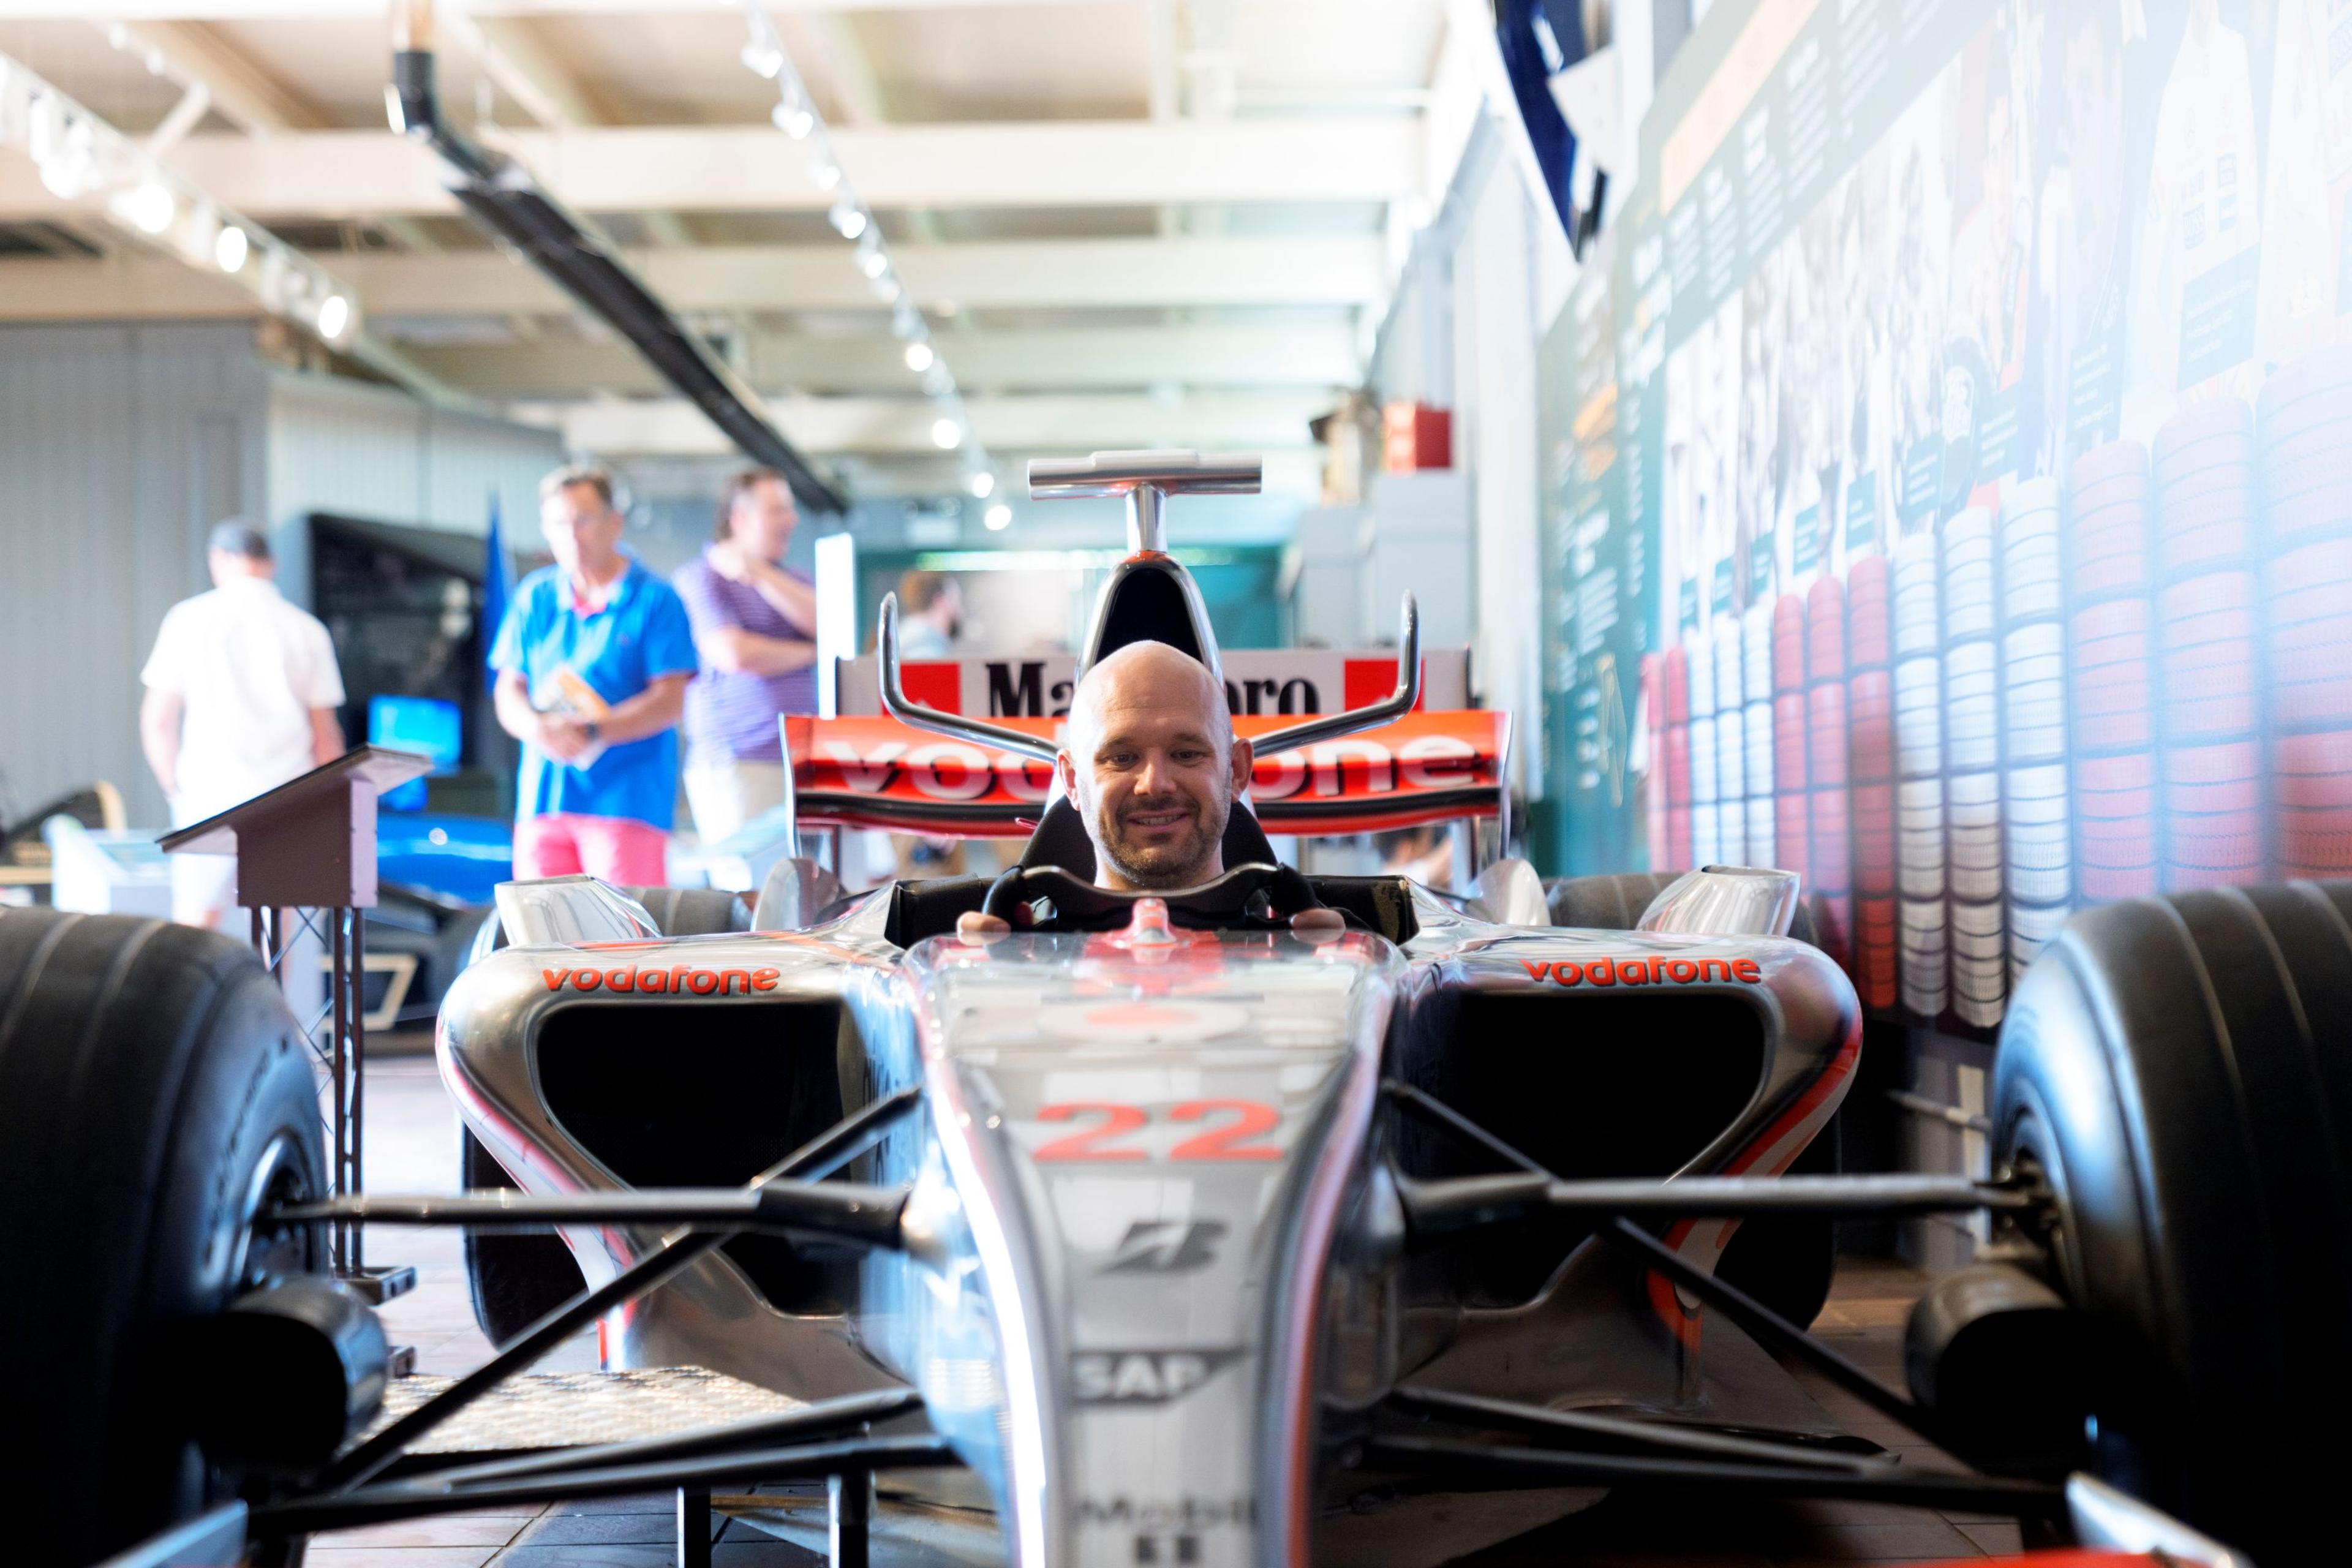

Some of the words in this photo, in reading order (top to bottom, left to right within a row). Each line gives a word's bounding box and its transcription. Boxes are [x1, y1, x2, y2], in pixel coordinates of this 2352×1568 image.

[542, 963, 781, 995] vodafone
[1520, 954, 1762, 987] vodafone
[1033, 1099, 1285, 1161] 22
[1072, 1354, 1208, 1399] SAP
